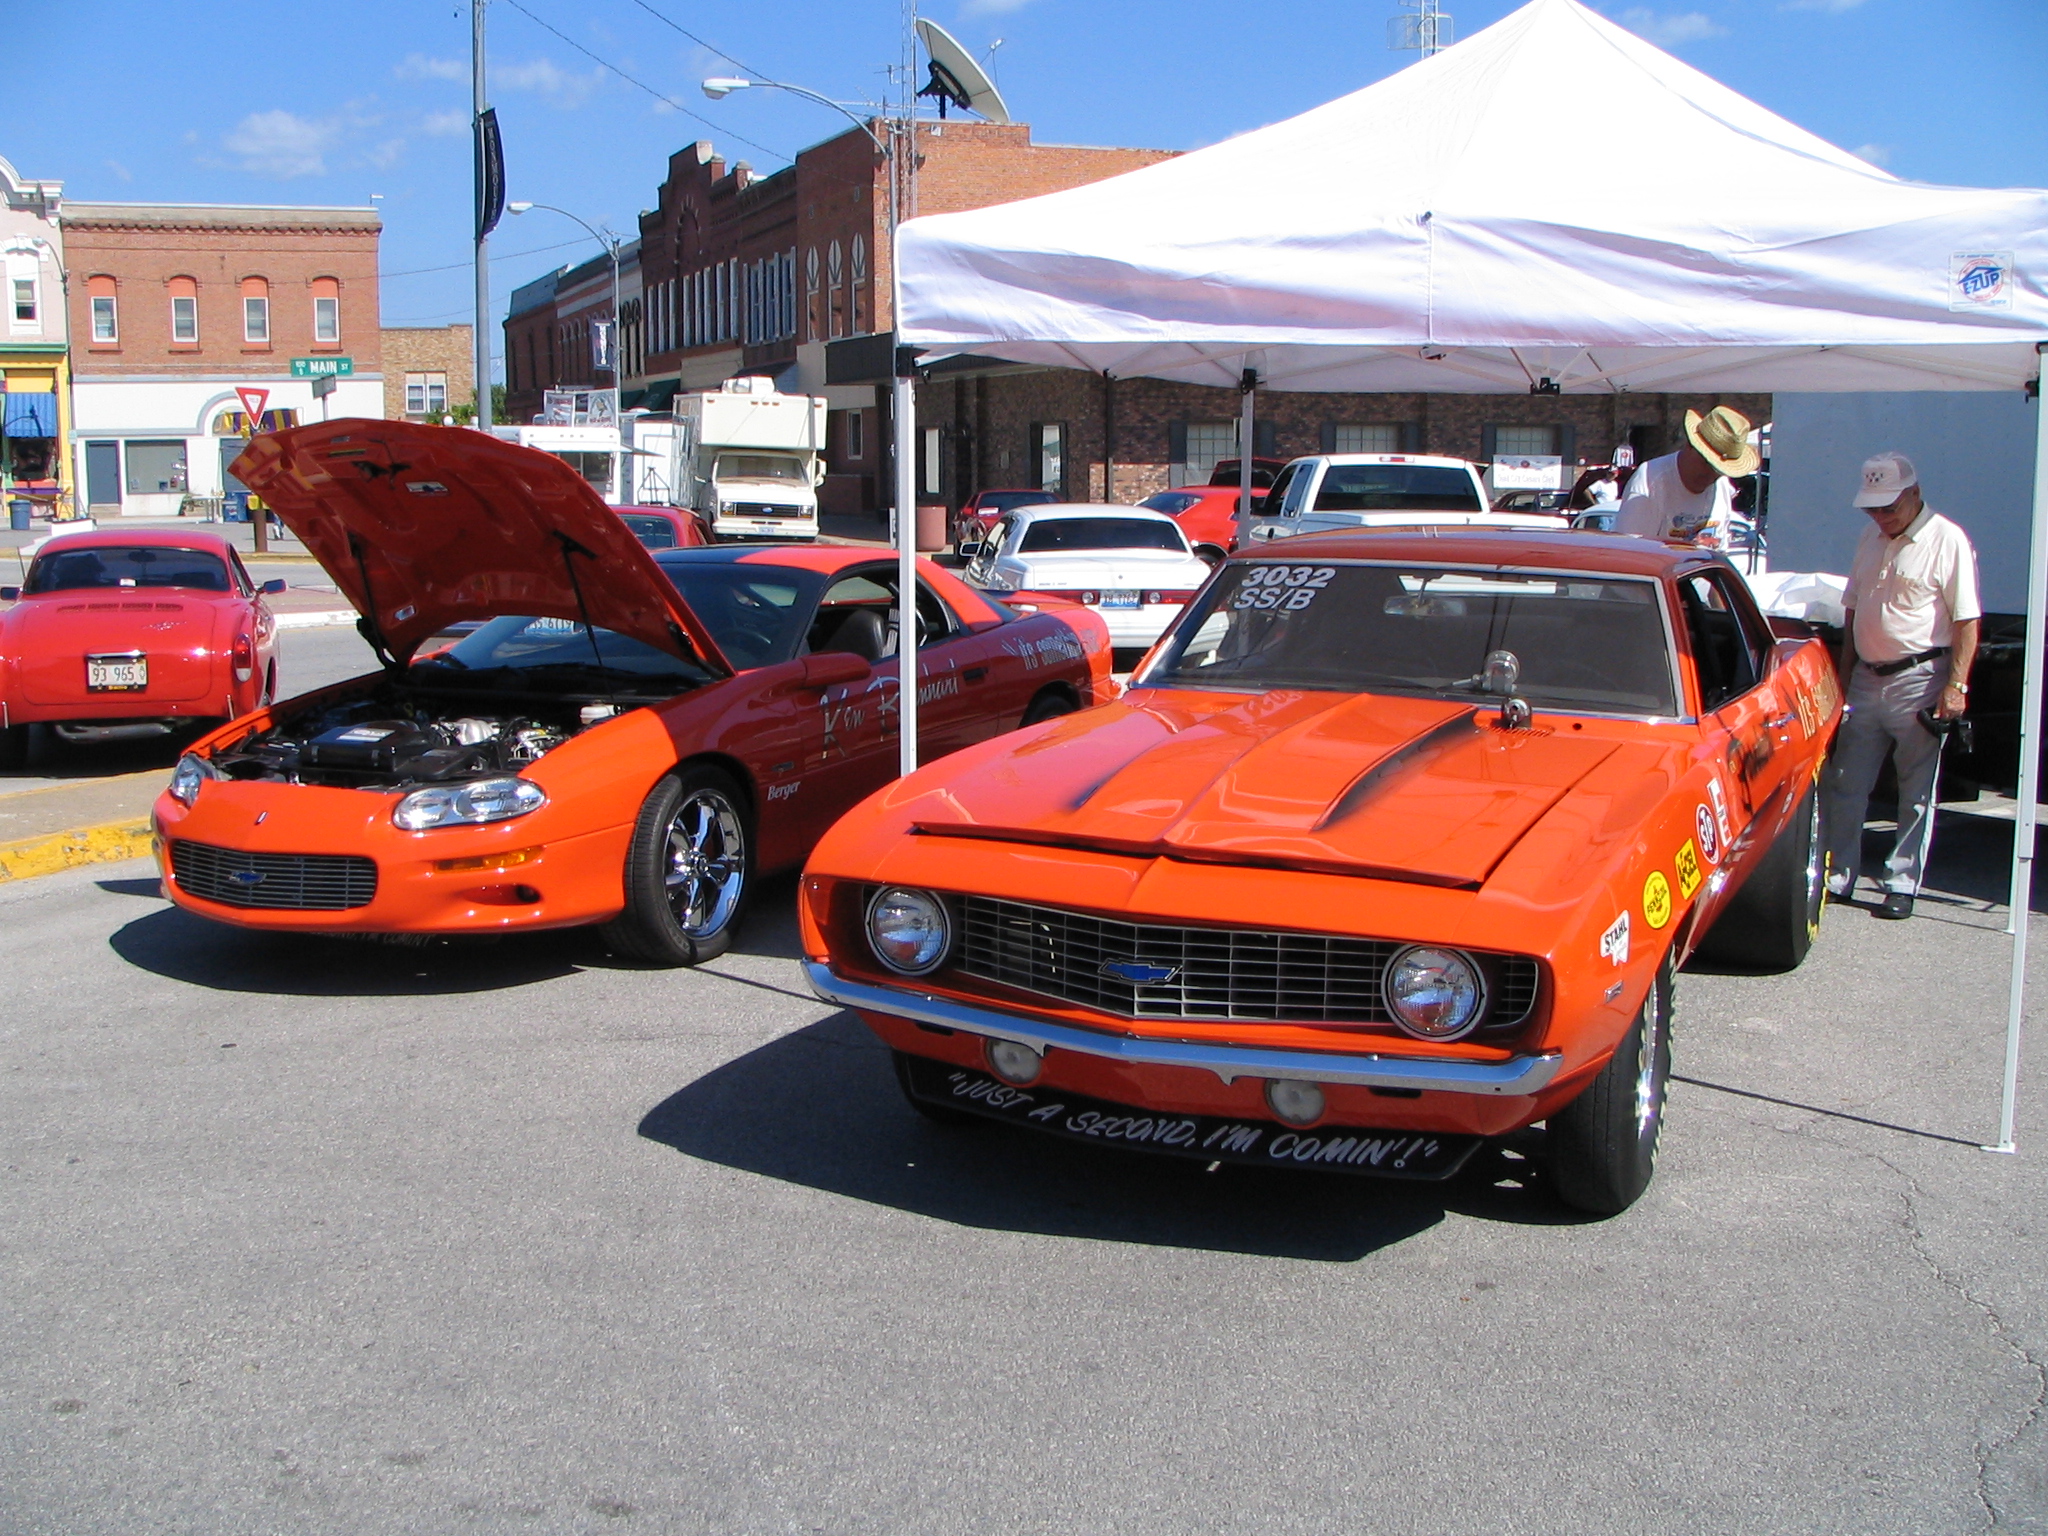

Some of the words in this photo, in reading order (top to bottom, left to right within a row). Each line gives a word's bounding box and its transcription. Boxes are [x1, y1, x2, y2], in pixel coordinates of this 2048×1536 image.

[310, 361, 337, 374] MAIN
[1242, 566, 1336, 588] 3032
[1234, 588, 1316, 610] SS/B
[92, 667, 107, 682] 93
[113, 666, 135, 681] 965
[767, 781, 801, 801] Berger
[1604, 918, 1627, 953] STAHL
[948, 1072, 1034, 1109] "JUST
[1029, 1103, 1065, 1122] A
[1066, 1112, 1197, 1147] SECOND,
[1202, 1124, 1263, 1152] I'M
